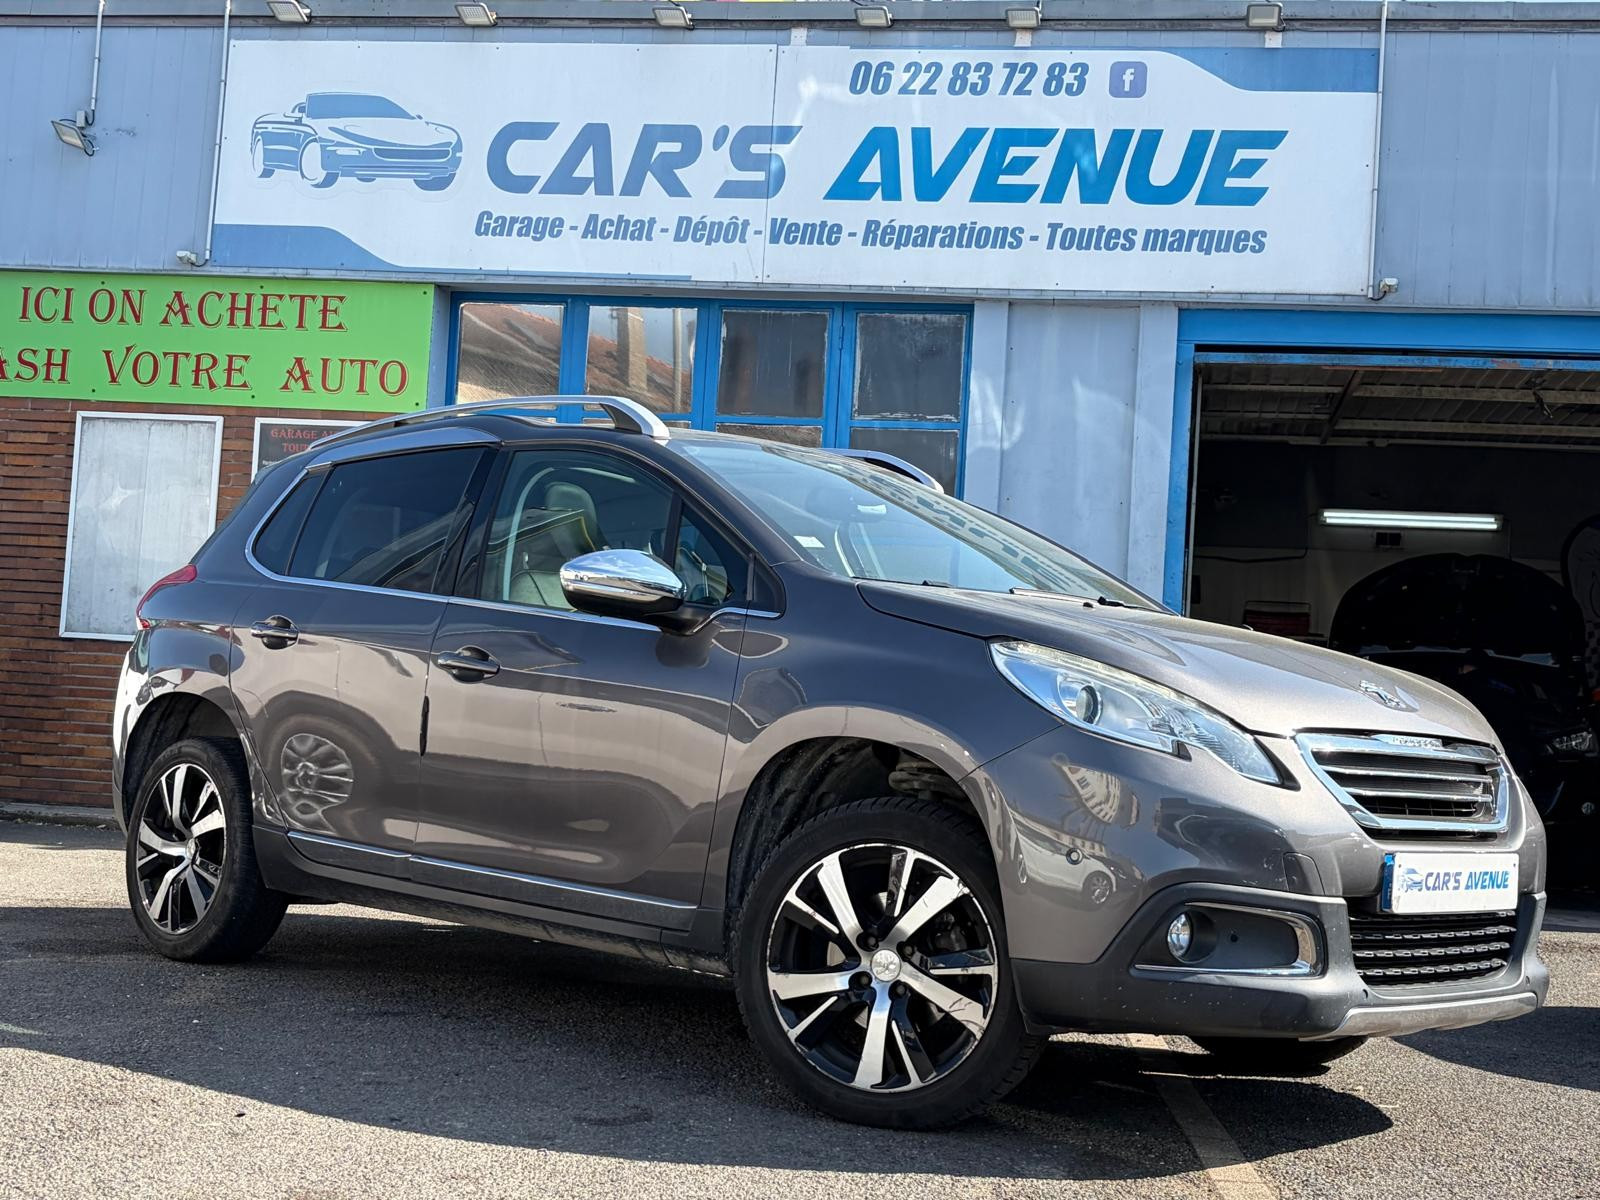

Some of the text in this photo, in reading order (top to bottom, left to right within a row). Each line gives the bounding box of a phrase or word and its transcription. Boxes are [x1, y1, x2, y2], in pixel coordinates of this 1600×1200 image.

[849, 60, 1089, 97] 06 22 83 72 83
[486, 121, 1289, 206] CAR'S AVENUE
[474, 210, 566, 242] Garage
[581, 213, 657, 242] Achat
[673, 214, 751, 246] Dépôt
[769, 217, 844, 247] Vente
[861, 218, 1024, 251] Réparations
[1046, 222, 1137, 252] Toutes
[1141, 228, 1268, 256] marques
[18, 285, 348, 333] ICI ON ACHETE
[101, 344, 253, 392] VOTRE
[280, 356, 410, 396] AUTO
[271, 428, 318, 439] GARAGE
[1424, 870, 1509, 891] CAR'S AVENUE
